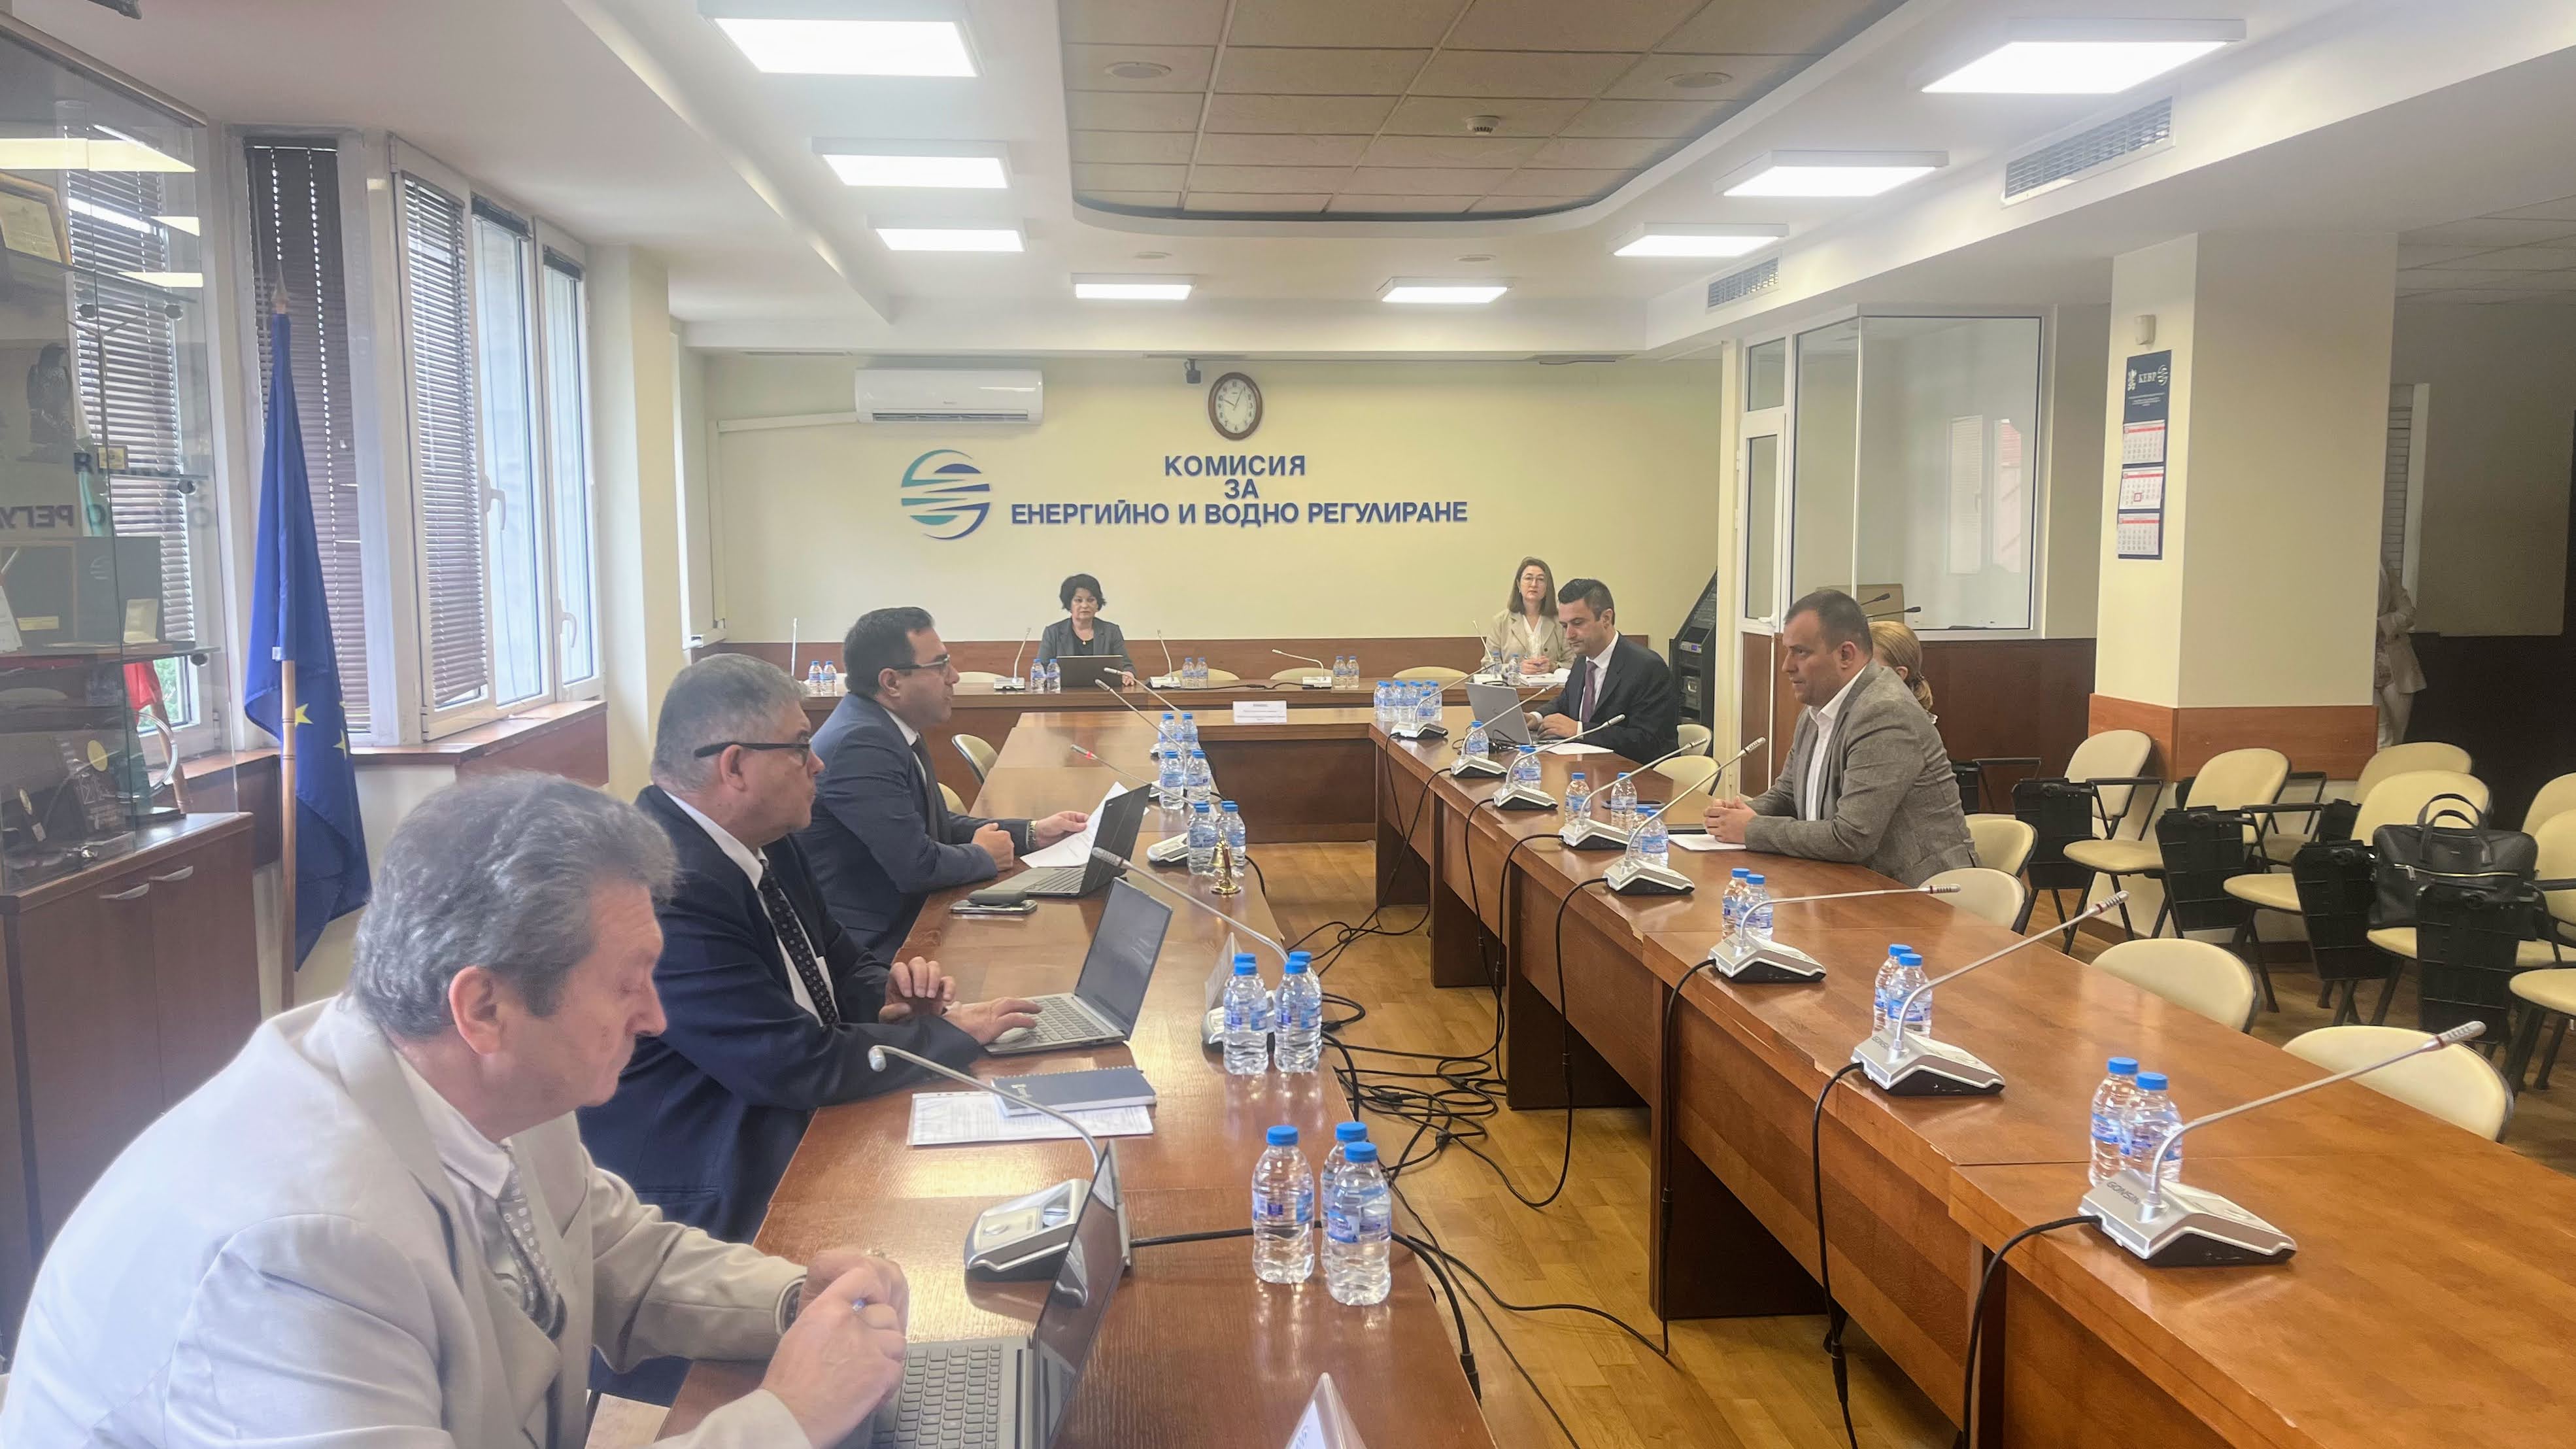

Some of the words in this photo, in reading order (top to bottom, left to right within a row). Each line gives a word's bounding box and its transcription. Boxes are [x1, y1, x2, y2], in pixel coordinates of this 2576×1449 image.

[1164, 455, 1305, 476] КОМИСИЯ
[1224, 479, 1259, 499] ЗА
[1011, 499, 1169, 524] ЕНЕРГИЙНО
[1179, 503, 1196, 524] И
[1205, 502, 1299, 528] ВОДНО
[1308, 502, 1467, 523] РЕГУЛИРАНЕ
